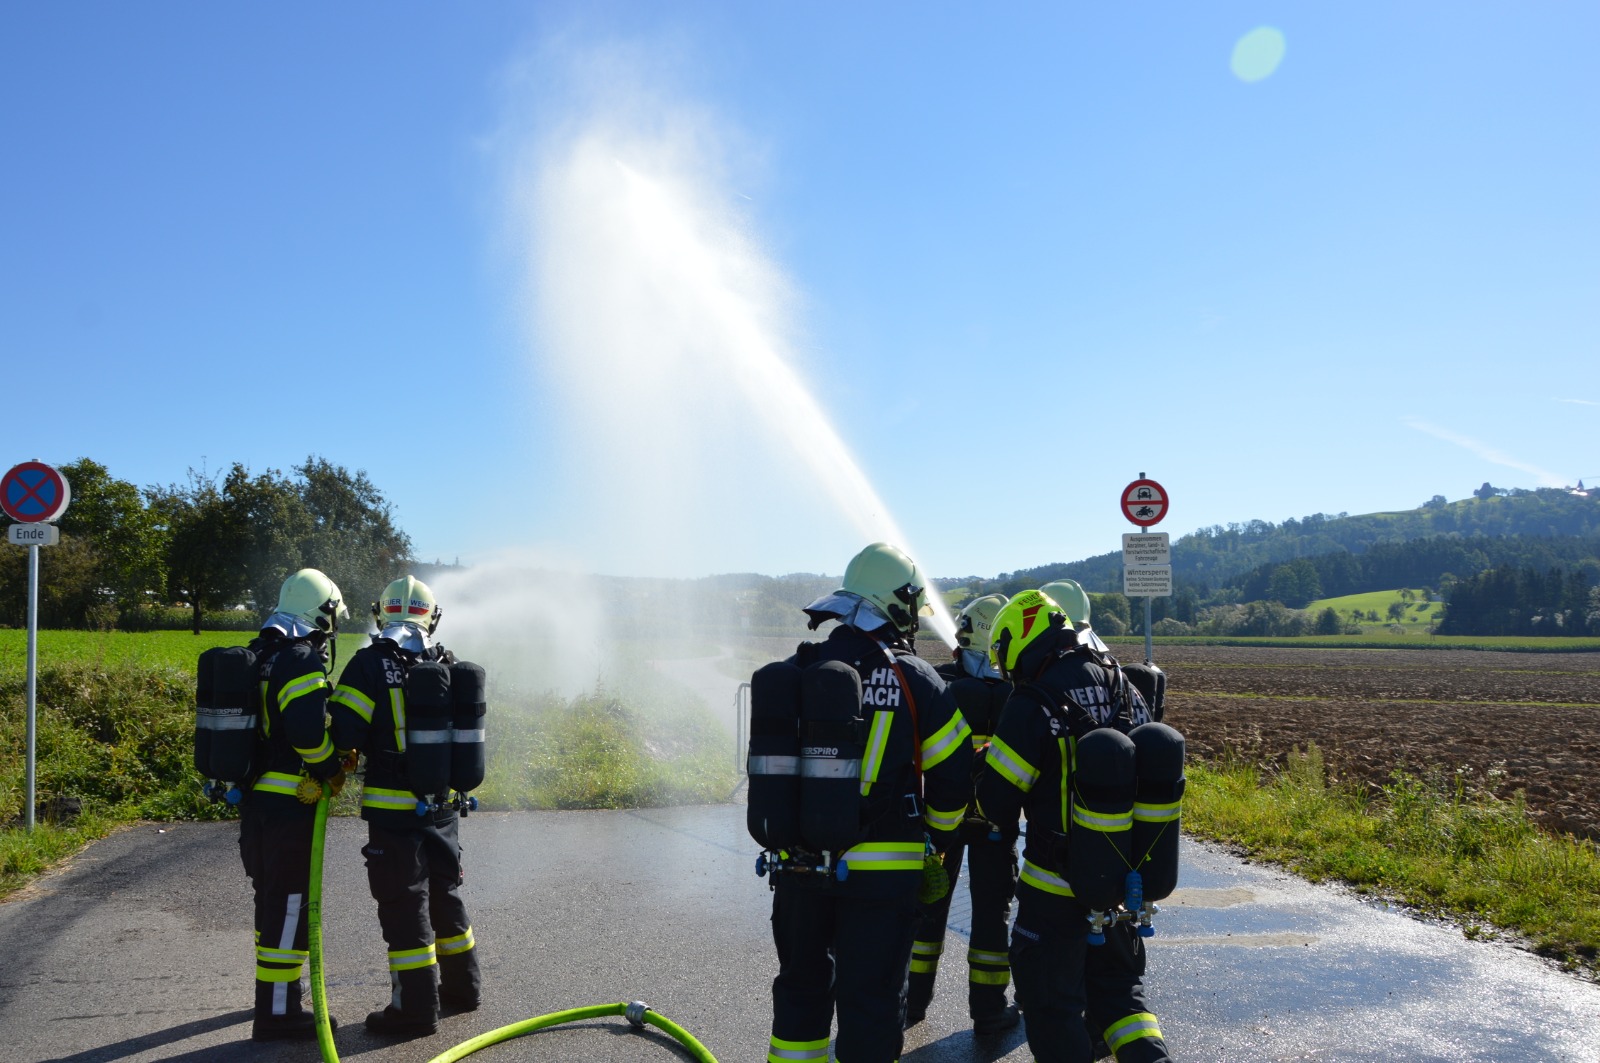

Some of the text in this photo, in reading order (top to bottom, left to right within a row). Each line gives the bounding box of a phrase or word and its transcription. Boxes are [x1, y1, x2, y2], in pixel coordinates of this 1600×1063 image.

[16, 528, 44, 539] Ende
[410, 599, 430, 608] WEHR
[976, 620, 992, 631] FEU
